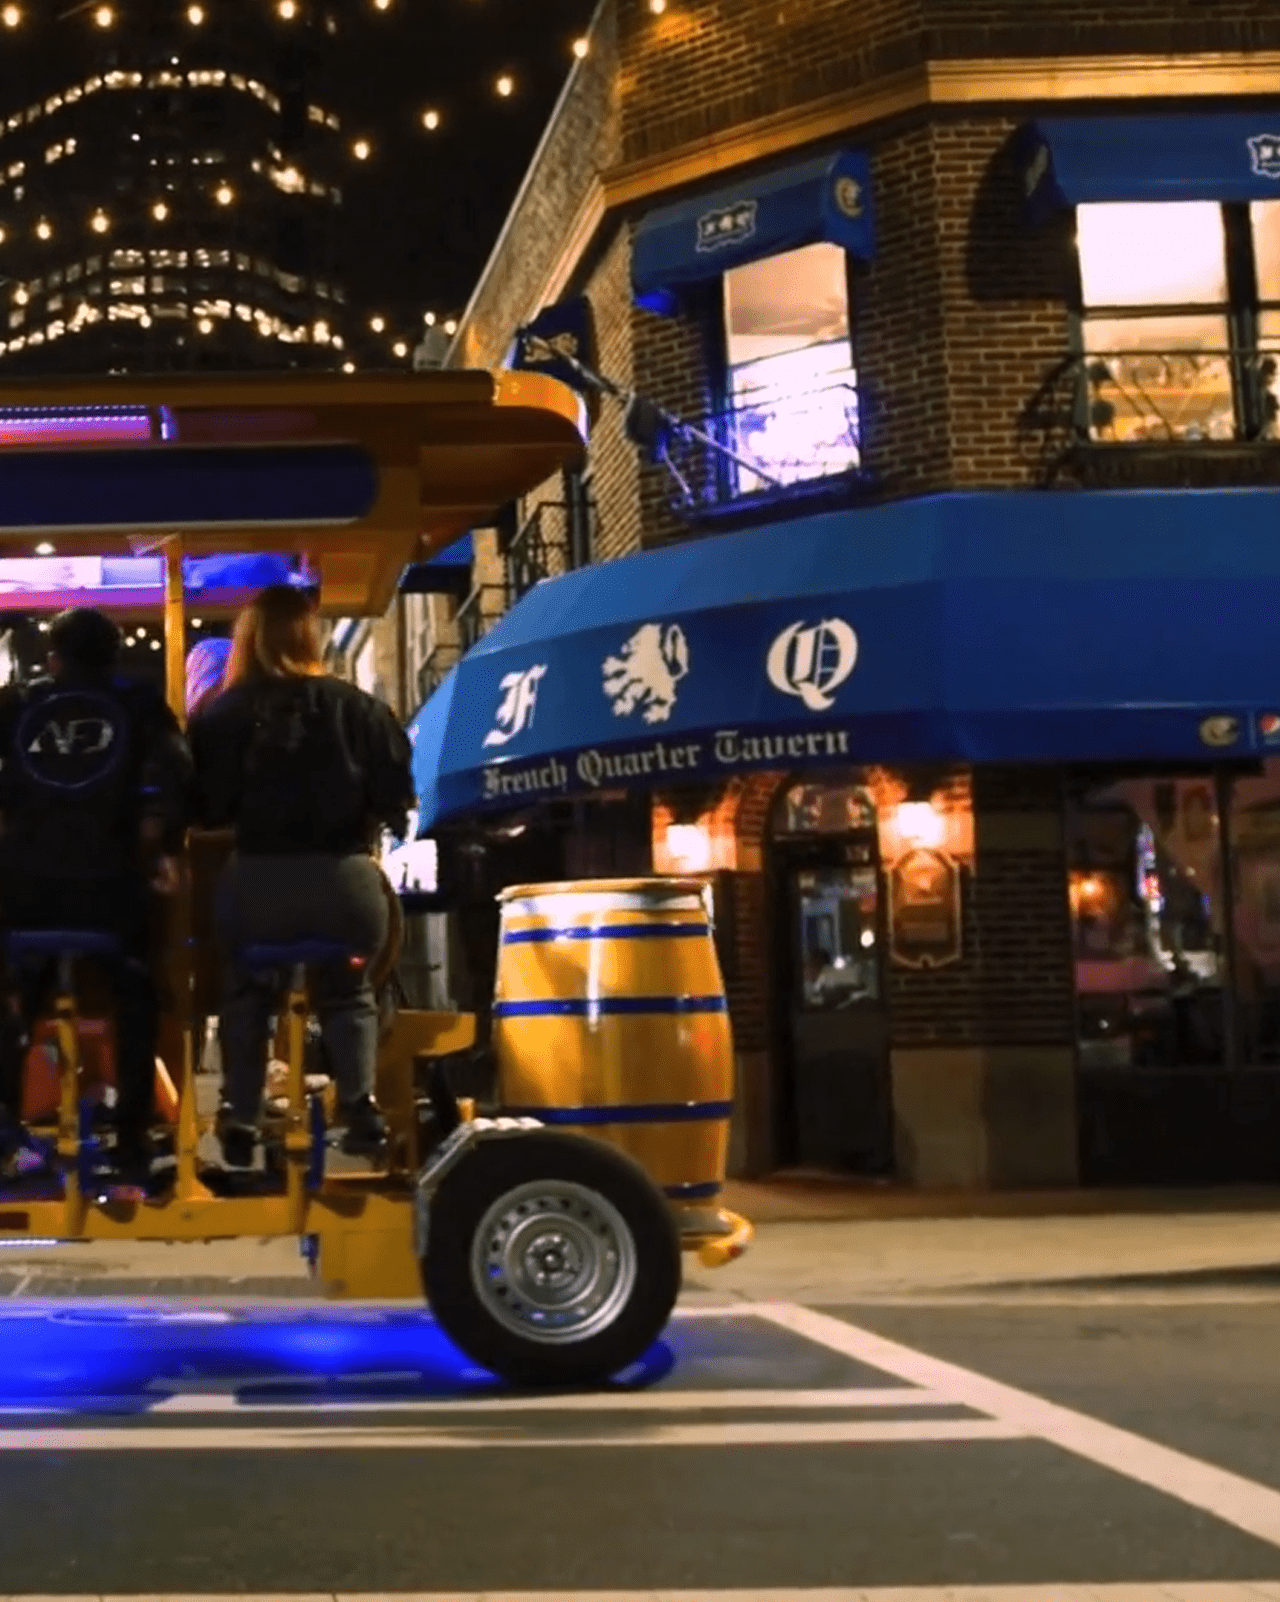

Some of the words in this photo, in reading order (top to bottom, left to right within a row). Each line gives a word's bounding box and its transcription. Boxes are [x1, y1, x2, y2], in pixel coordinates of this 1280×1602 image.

[766, 616, 858, 711] Q
[482, 757, 568, 800] French
[577, 742, 701, 787] Quarter
[715, 729, 848, 764] Tavern
